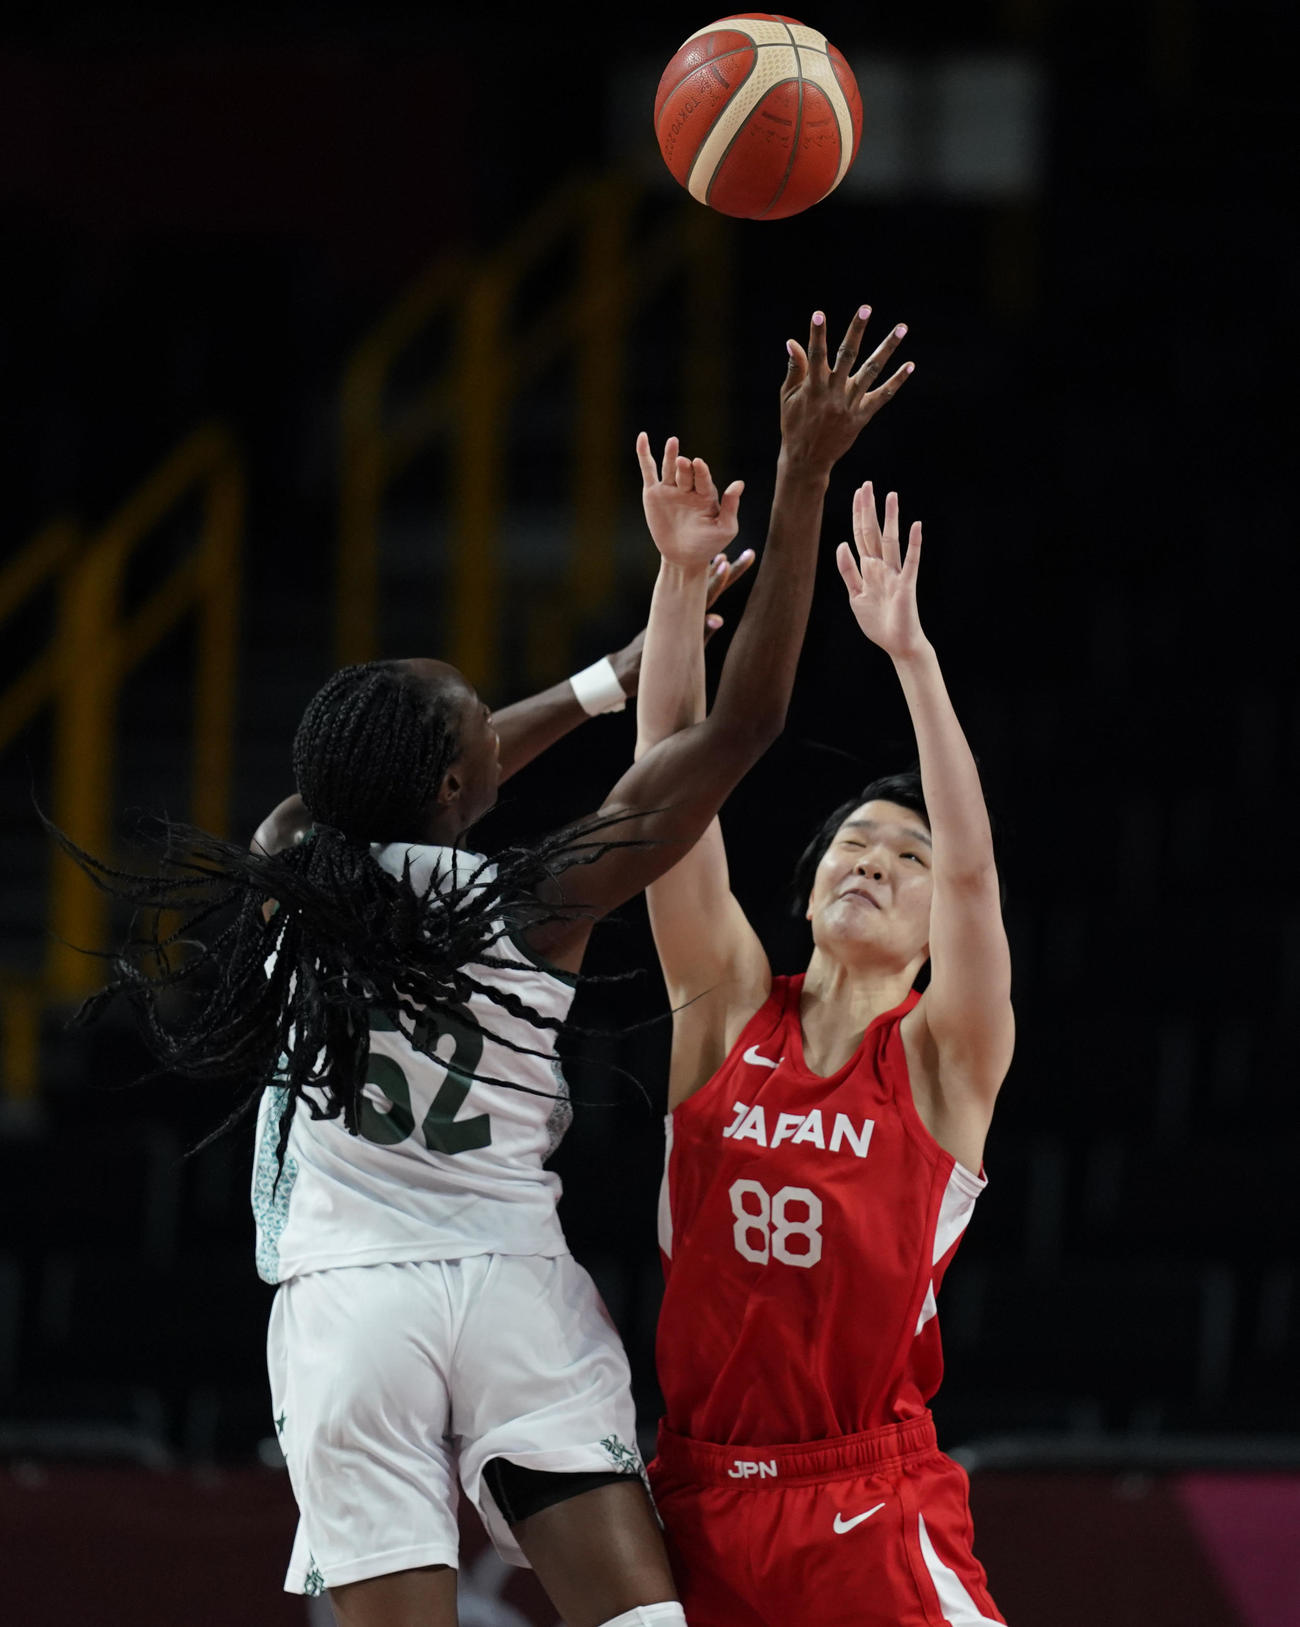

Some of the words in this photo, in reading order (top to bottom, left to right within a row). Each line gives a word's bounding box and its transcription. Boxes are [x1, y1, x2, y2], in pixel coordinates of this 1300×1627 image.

[672, 97, 701, 135] TOKYO
[722, 1100, 875, 1159] JAPAN
[728, 1178, 823, 1269] 88
[727, 1459, 778, 1479] JPN
